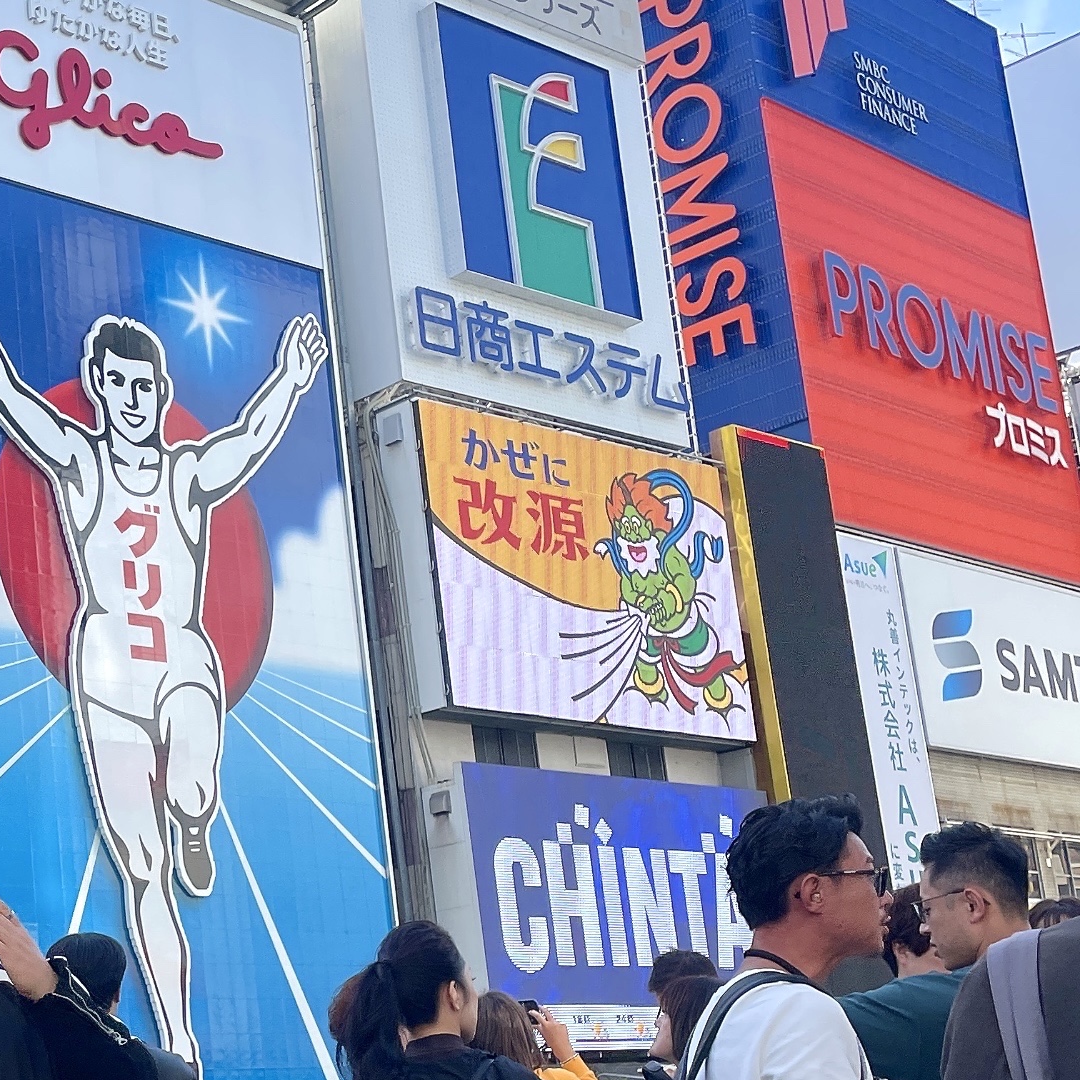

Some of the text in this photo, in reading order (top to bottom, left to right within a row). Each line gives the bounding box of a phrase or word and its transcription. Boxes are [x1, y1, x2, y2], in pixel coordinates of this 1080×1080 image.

[853, 51, 890, 84] SMBC
[856, 73, 929, 123] CONSUMER
[860, 94, 918, 136] FINANCE
[414, 286, 690, 412] 日商エステム
[823, 249, 1058, 414] PROMISE
[461, 428, 570, 487] かぜに
[985, 403, 1069, 470] プロミス
[453, 476, 590, 561] 改源
[113, 503, 168, 663] グリコ
[844, 553, 877, 577] Asue
[872, 648, 907, 772] 株式会社
[885, 609, 921, 764] 丸善インテックは、
